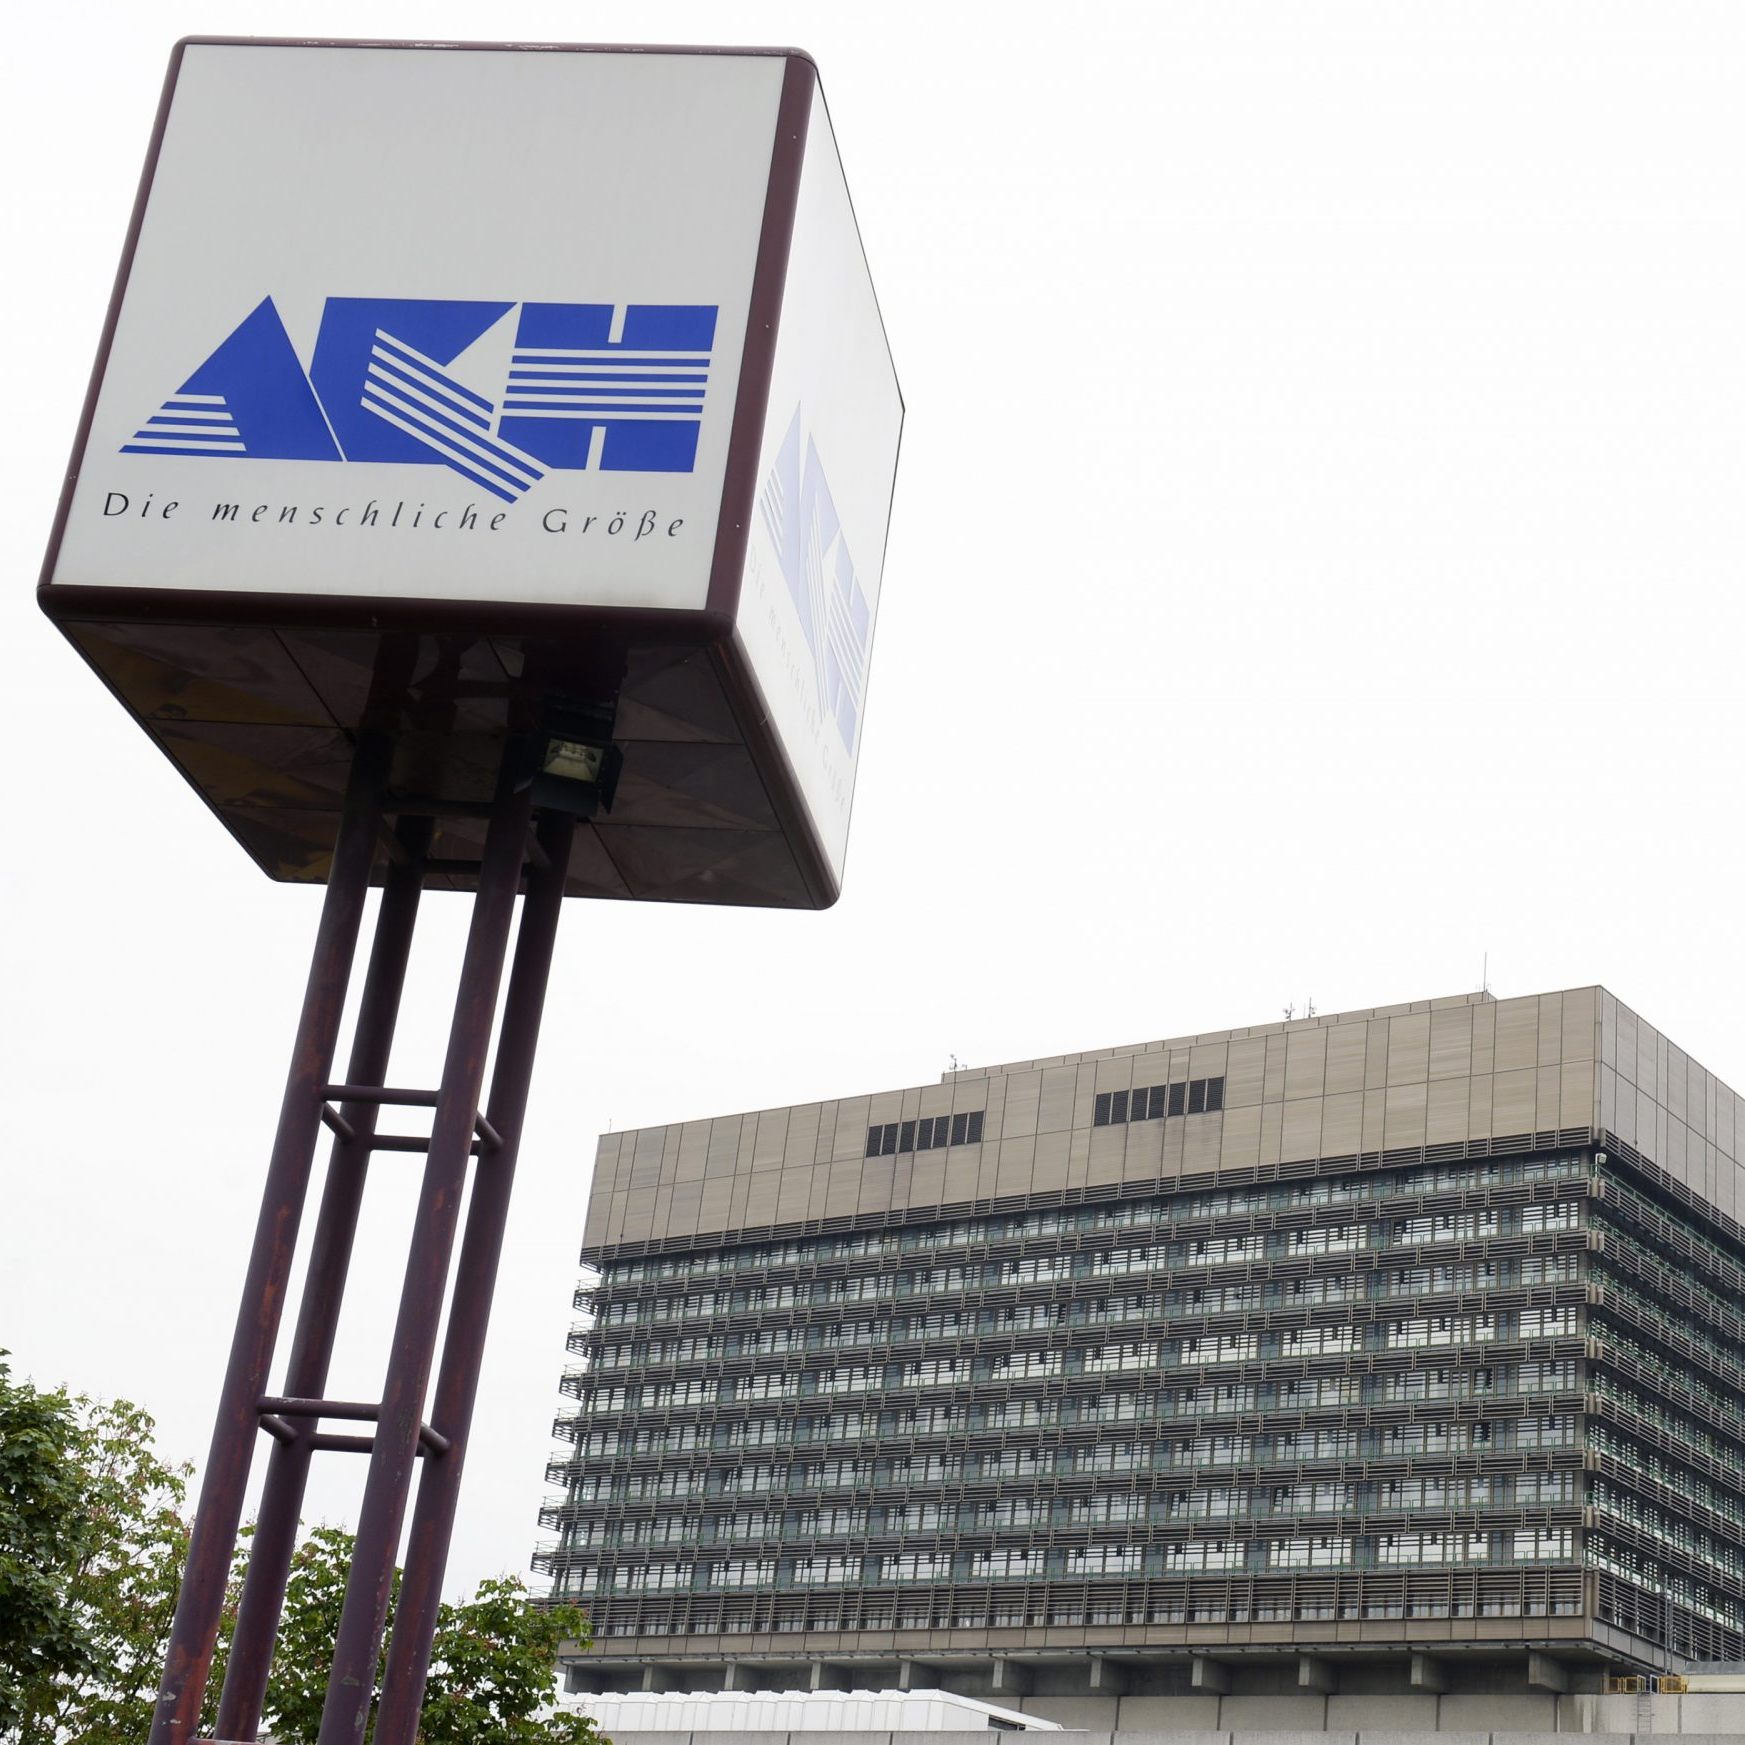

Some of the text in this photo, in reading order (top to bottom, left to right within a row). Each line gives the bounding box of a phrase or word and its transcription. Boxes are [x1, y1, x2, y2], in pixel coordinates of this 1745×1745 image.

[119, 294, 719, 503] AKH
[102, 491, 685, 542] Die menschliche Größe
